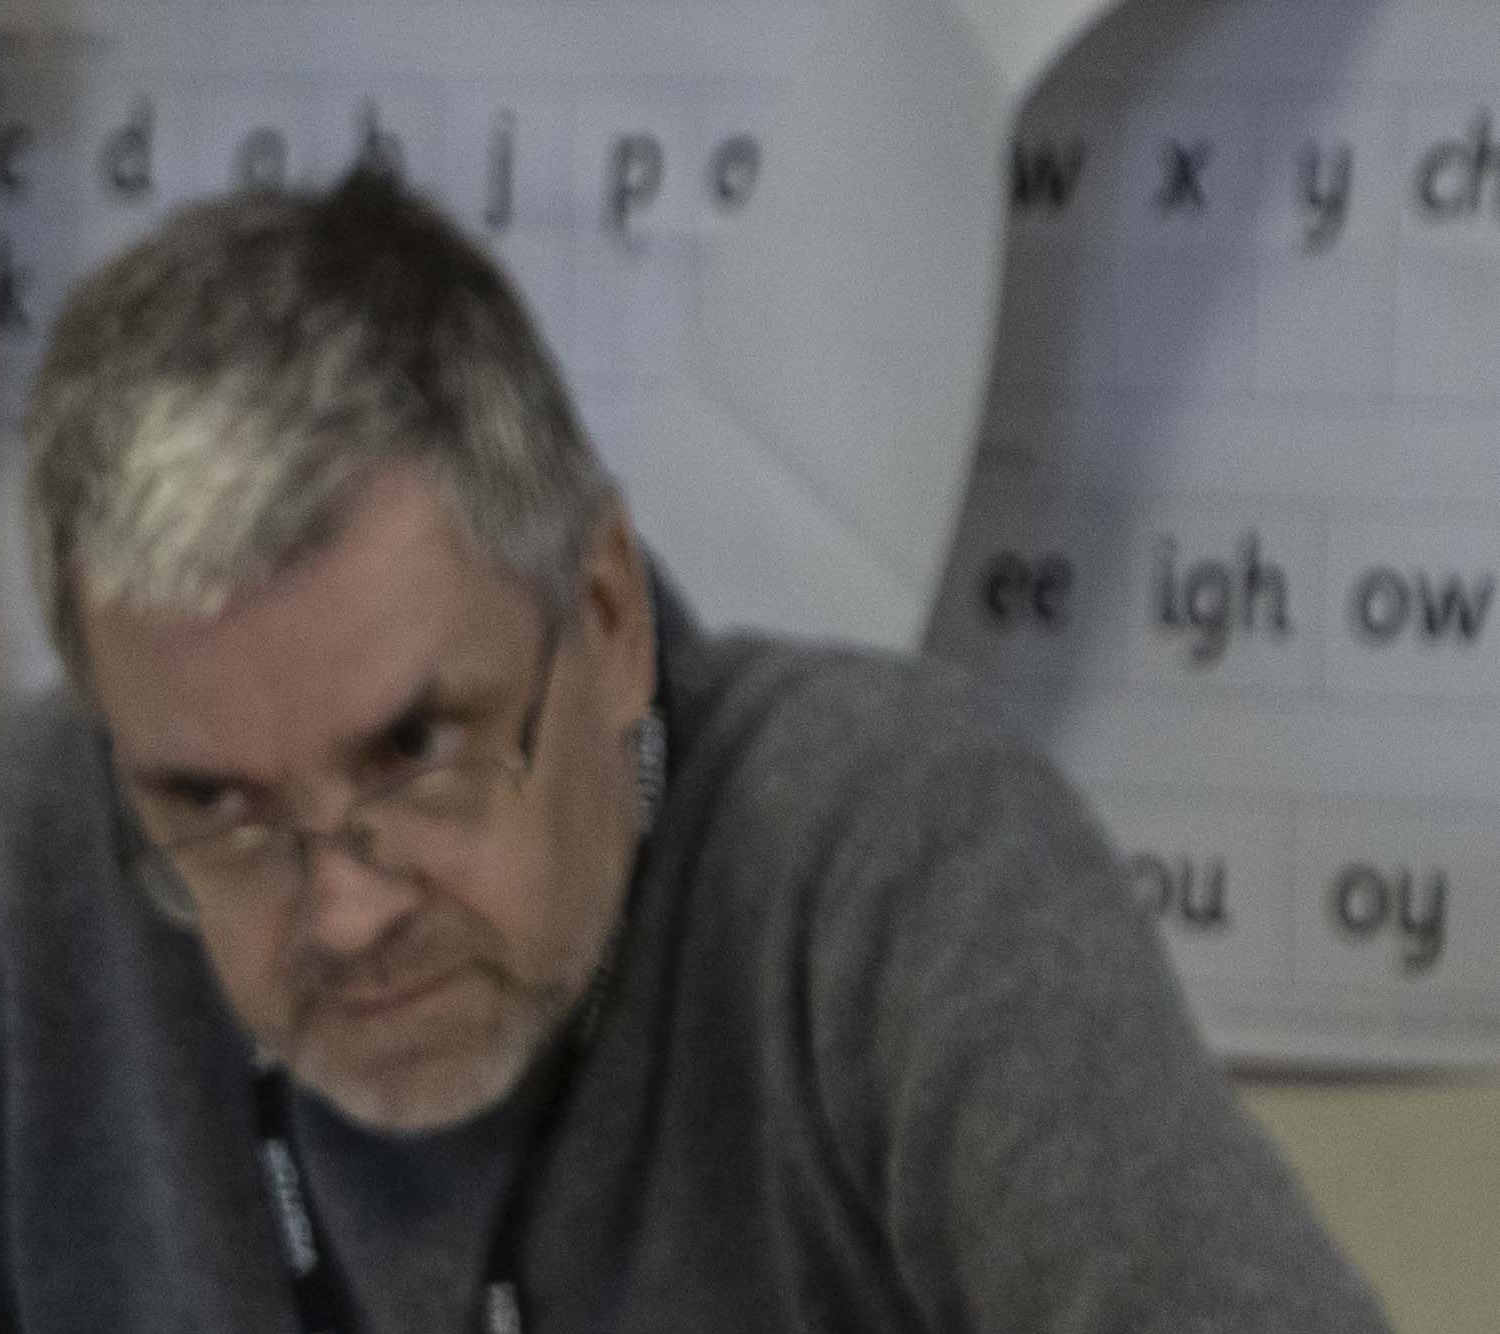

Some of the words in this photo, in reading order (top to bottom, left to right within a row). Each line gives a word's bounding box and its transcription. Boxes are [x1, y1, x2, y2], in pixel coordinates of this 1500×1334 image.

[602, 130, 666, 262] p
[1156, 138, 1211, 214] x
[1298, 140, 1353, 257] y
[1156, 531, 1293, 668] igh
[1353, 567, 1495, 645] ow
[1330, 861, 1448, 973] oy
